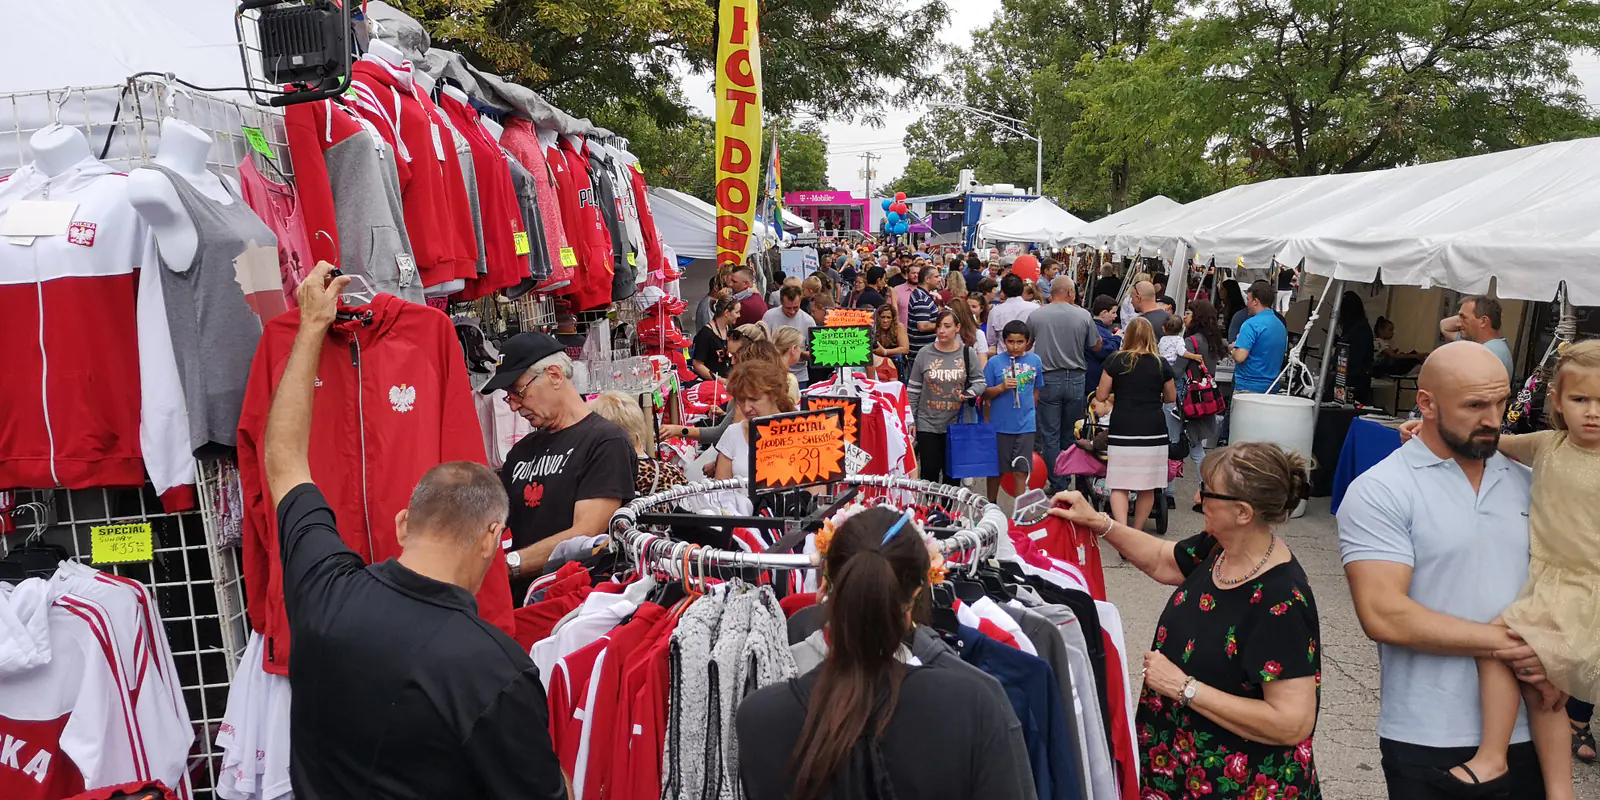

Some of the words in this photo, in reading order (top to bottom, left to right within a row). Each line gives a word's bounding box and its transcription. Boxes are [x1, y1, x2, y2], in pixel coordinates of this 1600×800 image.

[725, 6, 760, 126] HOT
[821, 331, 858, 340] SPECIAL
[770, 421, 826, 436] SPECIAL
[760, 436, 794, 450] HOODIES
[846, 443, 863, 461] ASK
[98, 526, 145, 536] SPECIAL
[0, 733, 52, 784] KA
